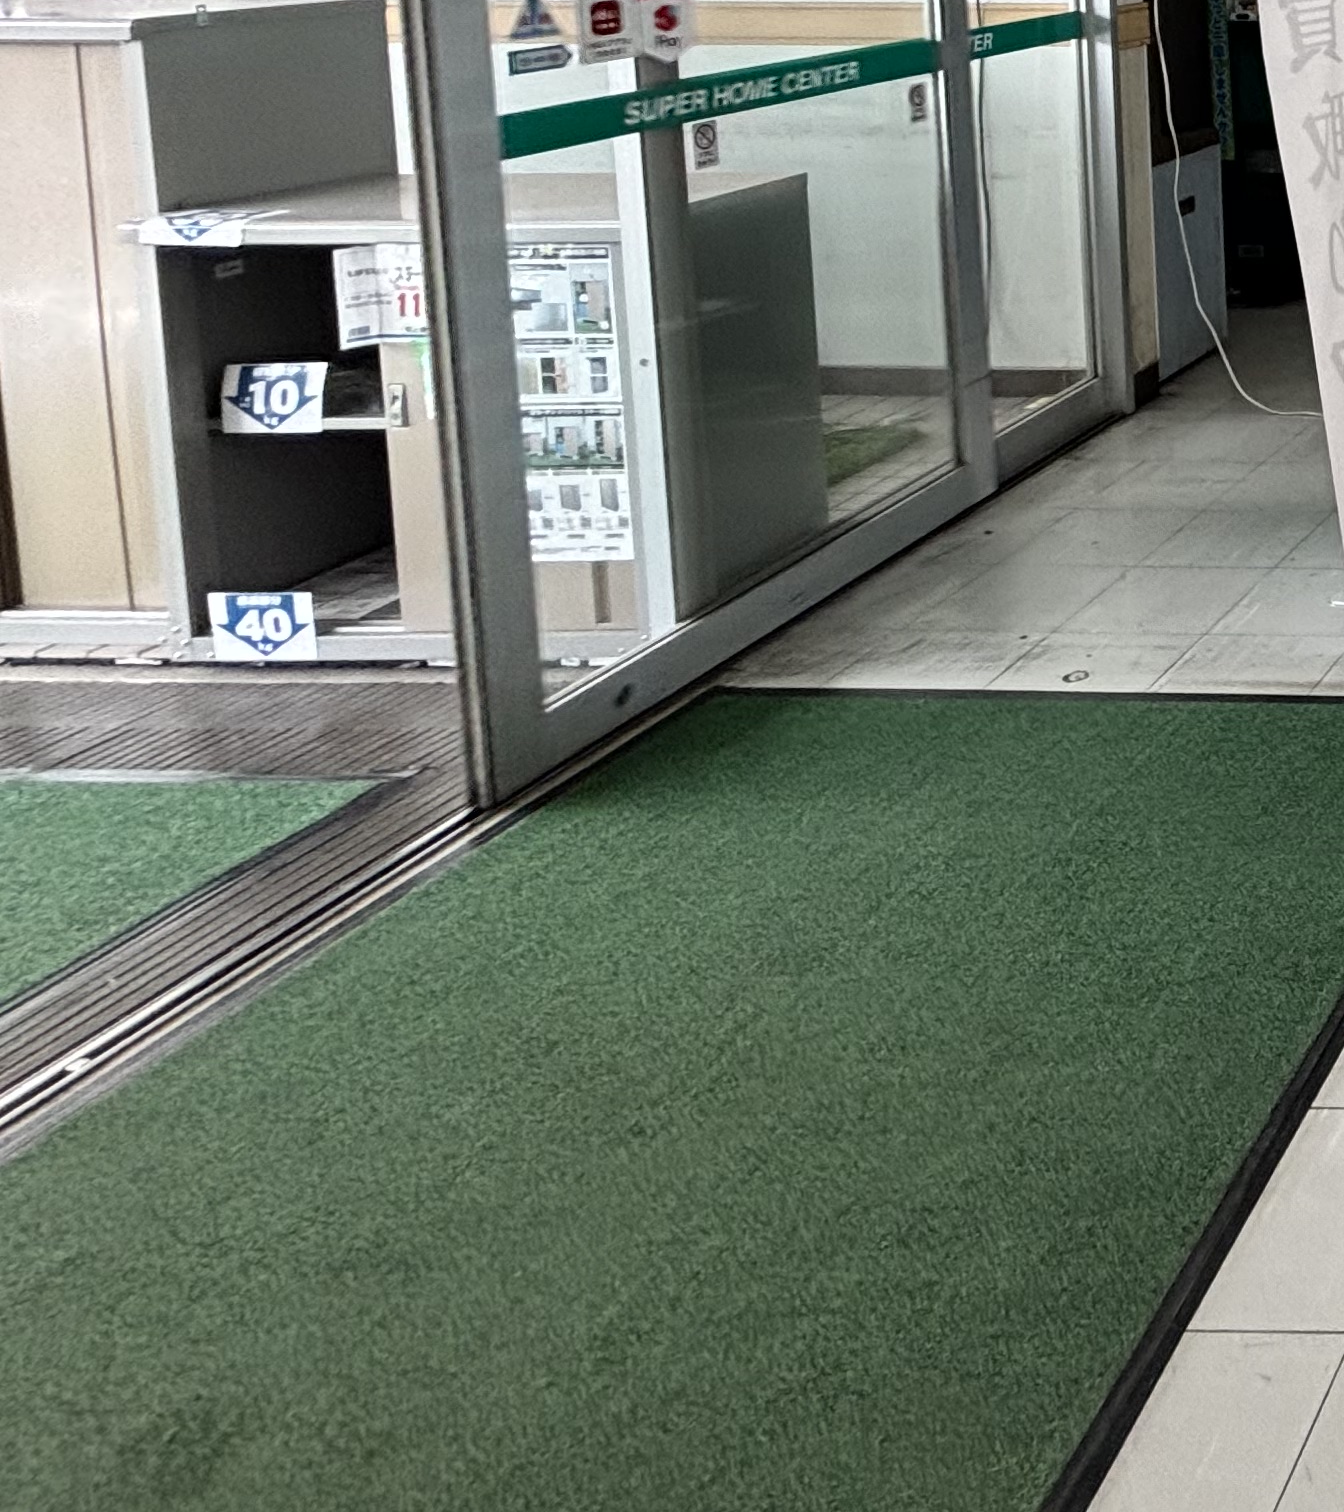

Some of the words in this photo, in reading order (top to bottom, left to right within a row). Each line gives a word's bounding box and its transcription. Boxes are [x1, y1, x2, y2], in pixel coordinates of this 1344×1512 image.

[624, 87, 709, 126] SUPER
[713, 74, 779, 108] HOME
[781, 60, 861, 98] CENTER
[249, 380, 299, 415] 10
[235, 608, 293, 642] 40
